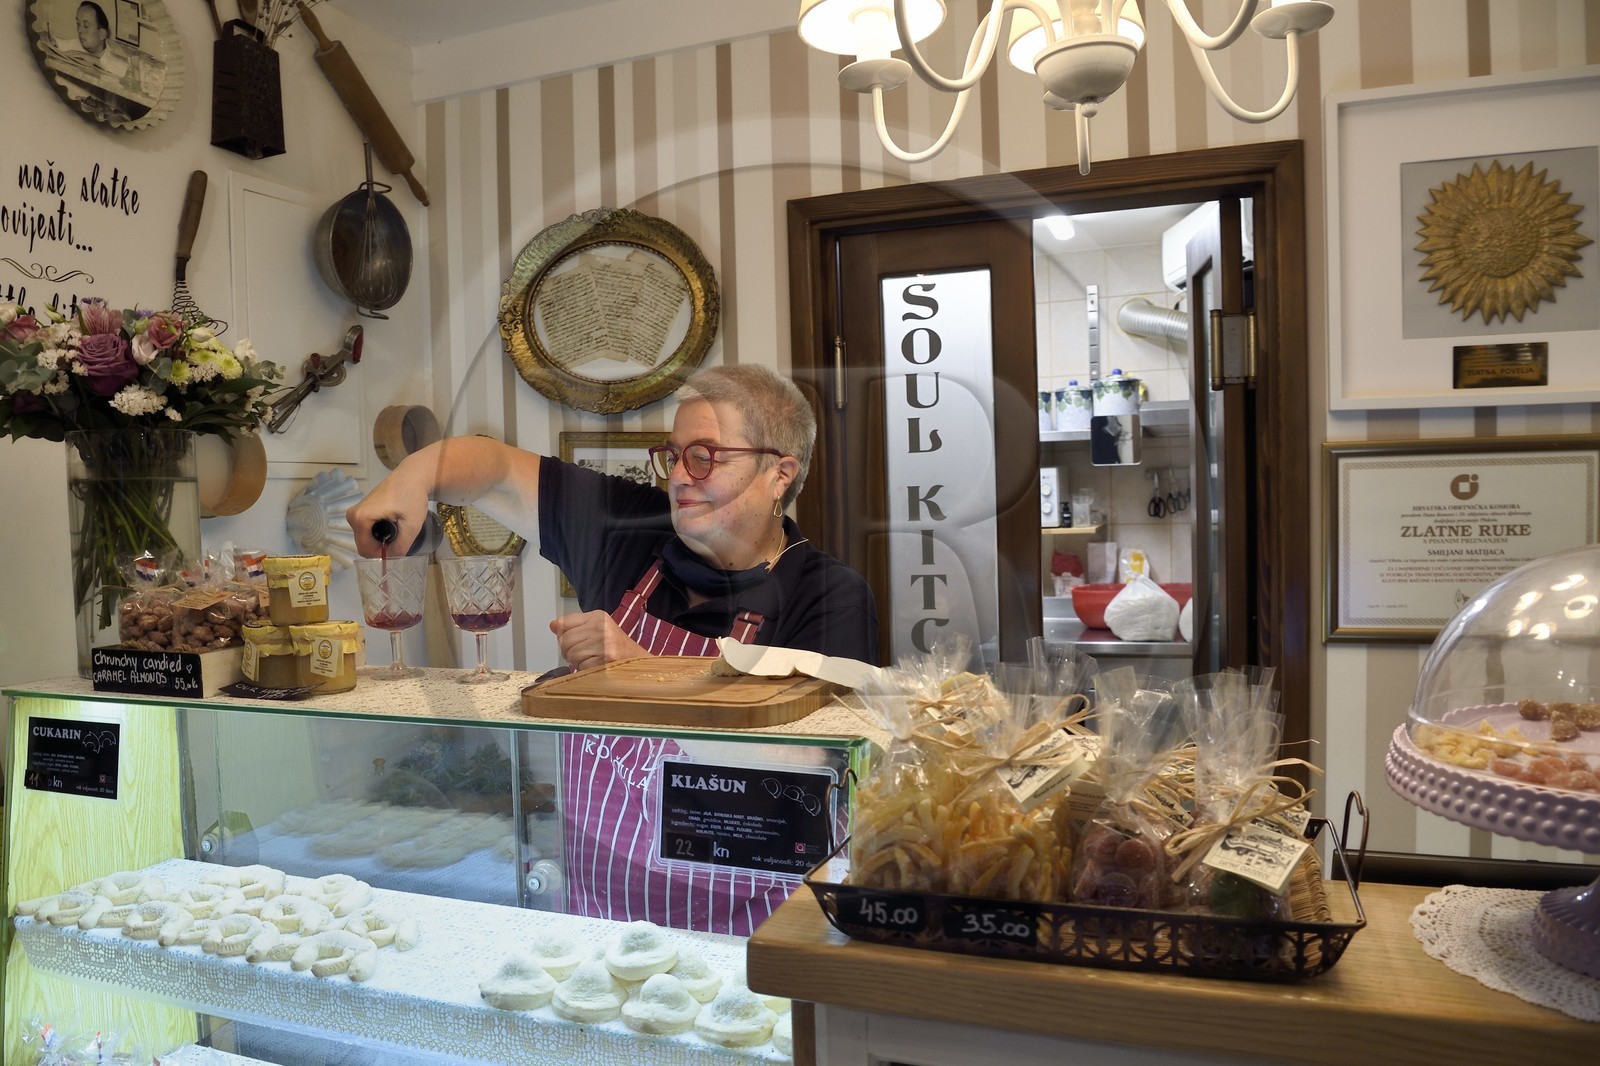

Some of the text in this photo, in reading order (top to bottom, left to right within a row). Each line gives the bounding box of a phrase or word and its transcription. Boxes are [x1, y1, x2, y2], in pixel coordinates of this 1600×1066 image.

[18, 159, 140, 216] naše slatke
[901, 283, 943, 454] SOUL
[1400, 524, 1532, 538] ZLATNE RUKE
[142, 653, 182, 672] candied
[93, 670, 168, 684] CARAMEL ALMONDS
[32, 726, 81, 740] CUKARIN
[53, 776, 63, 788] kn
[671, 774, 747, 794] KLAŠUN
[675, 838, 730, 858] 22 kn
[859, 898, 918, 925] 45.00
[962, 914, 1030, 938] 35.00
